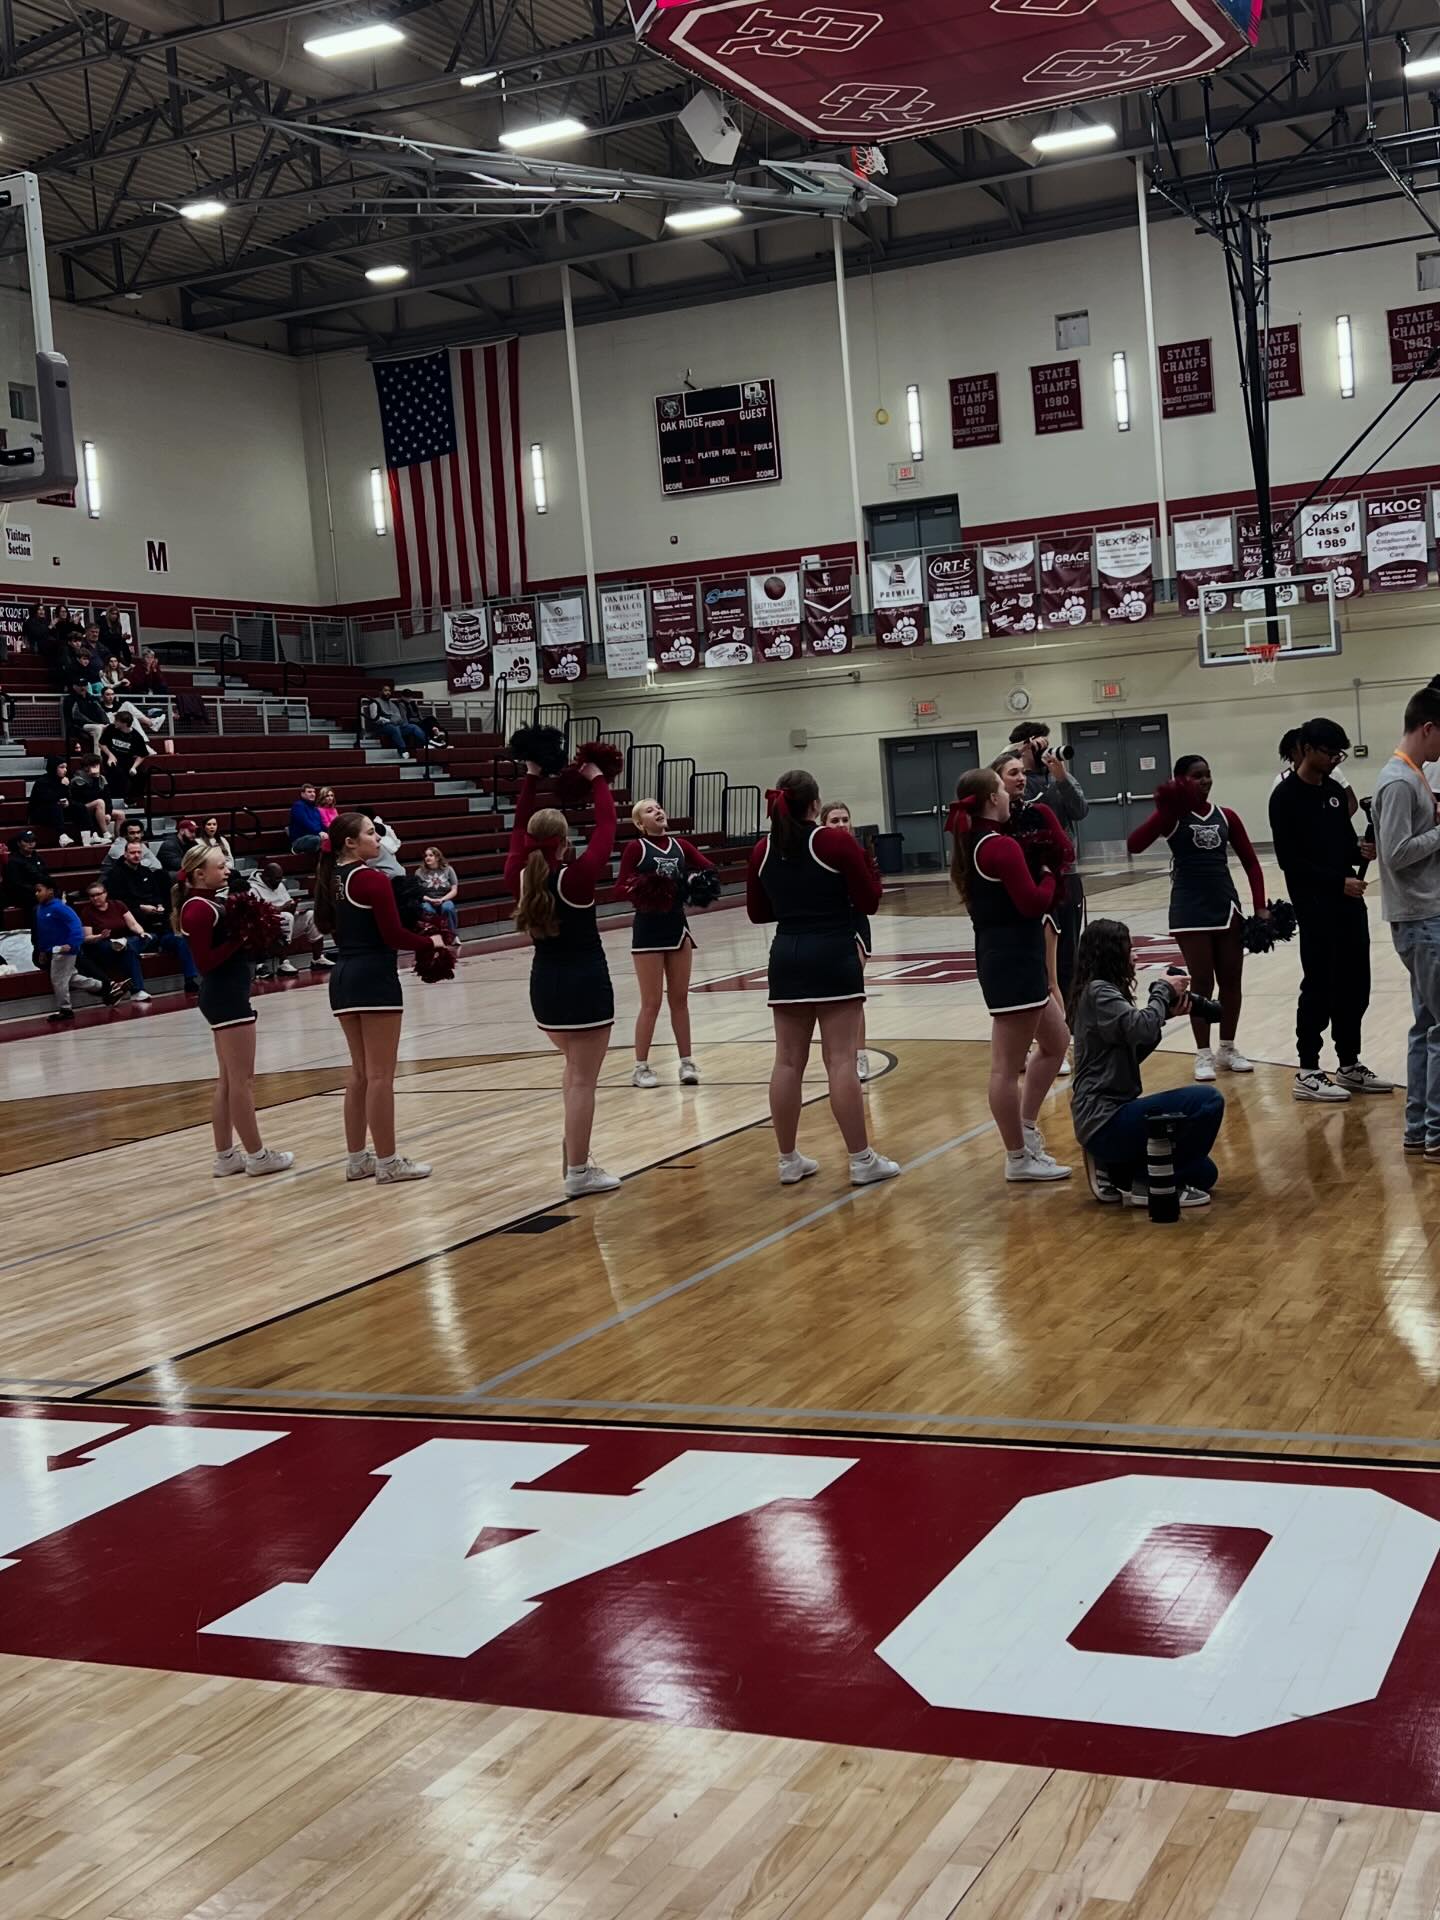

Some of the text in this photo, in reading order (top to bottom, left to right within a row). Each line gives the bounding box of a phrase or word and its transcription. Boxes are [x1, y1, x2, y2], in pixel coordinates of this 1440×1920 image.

[1396, 309, 1434, 325] STATE
[1167, 346, 1201, 361] STATE
[1162, 357, 1207, 373] CHAMPS
[1038, 367, 1071, 380] STATE
[957, 380, 989, 393] STATE
[1034, 379, 1077, 394] CHAMPS
[952, 390, 995, 406] CHAMPS
[739, 407, 767, 420] GUEST
[1040, 409, 1076, 421] FOOTBALL
[660, 417, 704, 432] OAK RIDGE
[753, 442, 773, 451] FOULS
[697, 448, 737, 459] PLAYER FOUL
[663, 456, 681, 465] FOULS
[709, 476, 730, 484] MATCH
[756, 469, 775, 478] SCORE
[665, 482, 683, 491] SCORE
[1382, 499, 1421, 513] KOC
[1312, 510, 1348, 522] ORHS
[6, 528, 31, 542] Visitors
[1305, 522, 1355, 537] Class of
[8, 543, 31, 556] Section
[1317, 538, 1347, 549] 1989
[147, 540, 168, 571] M
[1055, 551, 1090, 563] GRACE
[8, 621, 24, 632] NEW
[882, 630, 914, 641] ORHS
[660, 650, 692, 660] ORHS
